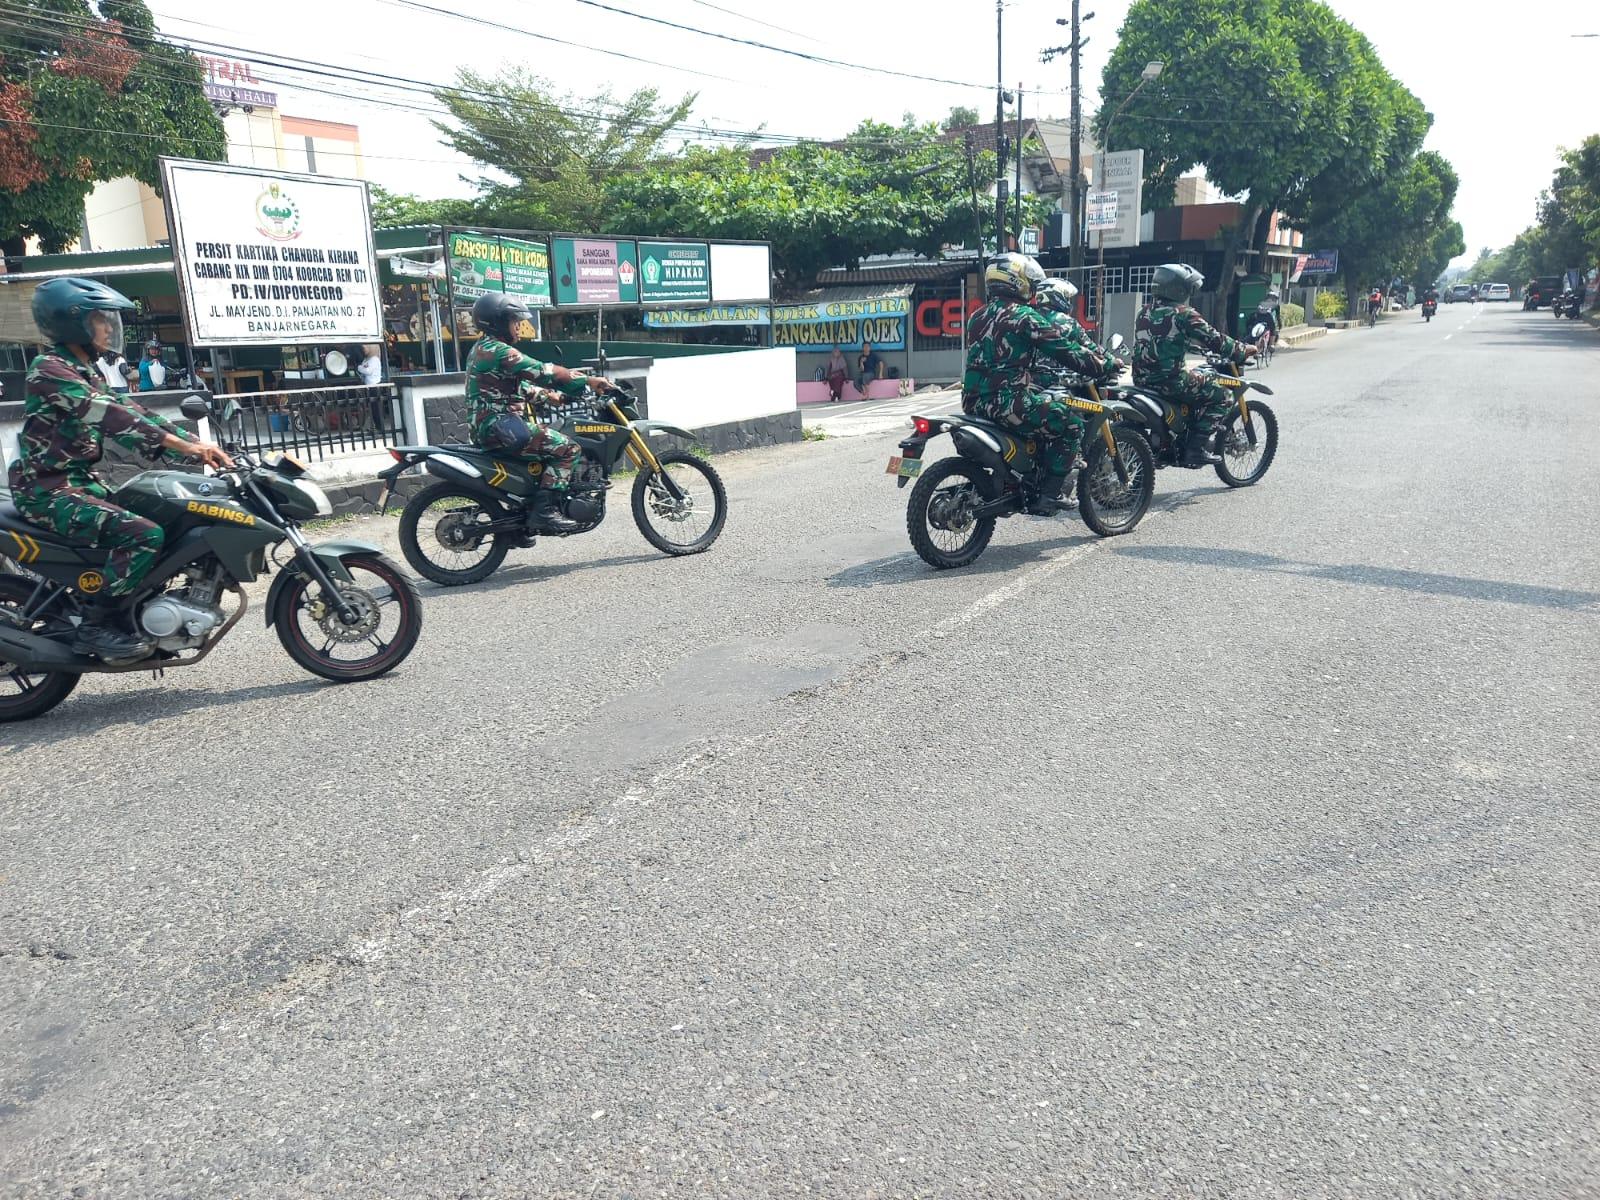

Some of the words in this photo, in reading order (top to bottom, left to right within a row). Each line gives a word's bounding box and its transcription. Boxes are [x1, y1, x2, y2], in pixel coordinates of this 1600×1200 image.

[245, 91, 274, 105] HALL
[196, 242, 231, 259] PERSIT
[236, 245, 278, 261] KARTIKA
[281, 247, 325, 263] CHANDRA
[328, 250, 359, 265] KIRANA
[454, 238, 488, 261] BAKSO
[490, 245, 508, 263] PAK
[509, 248, 524, 266] TRI
[582, 248, 611, 258] SANGGAR
[194, 262, 232, 279] CABANG
[235, 264, 250, 280] XIX
[252, 265, 270, 280] DIM
[273, 266, 293, 281] 0704
[296, 267, 333, 282] KOORCAB
[336, 268, 351, 282] REM
[354, 269, 366, 283] 071
[665, 266, 703, 279] HIPAKAD
[209, 305, 224, 318] JL.
[292, 306, 339, 317] PANJAITAN
[357, 306, 366, 317] 27
[648, 306, 760, 323] PANGKALAN
[767, 306, 820, 322] OJEK
[248, 320, 337, 332] BANJARNEGARA
[862, 318, 902, 344] OJEK
[1065, 397, 1104, 414] BABINSA
[574, 424, 617, 433] BABINSA
[187, 500, 256, 526] BABINSA
